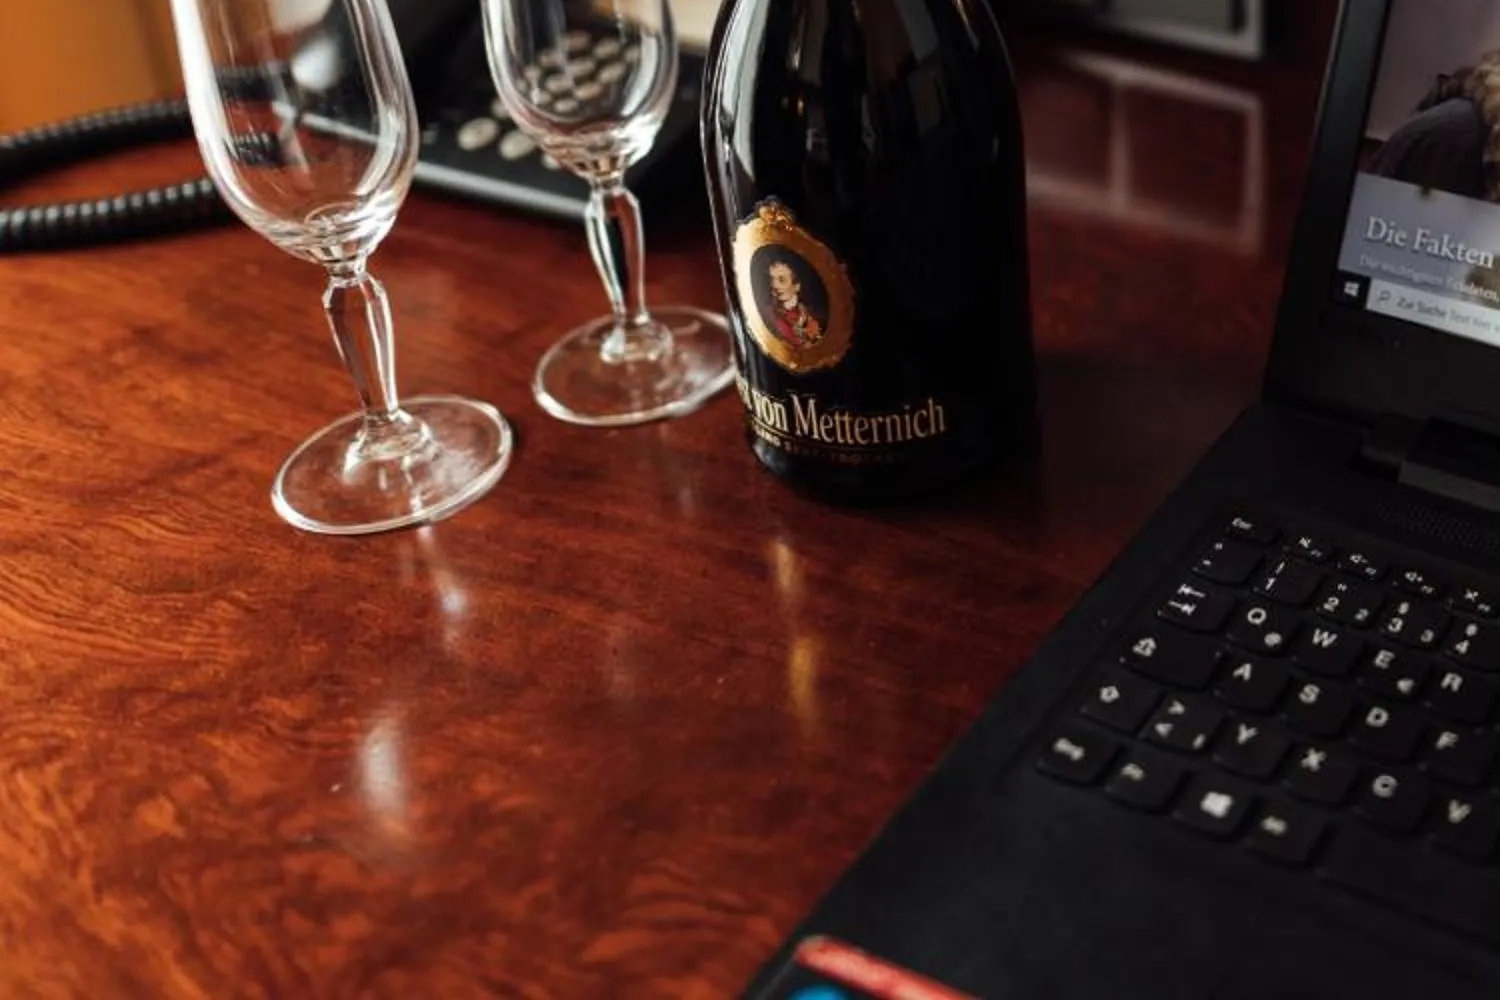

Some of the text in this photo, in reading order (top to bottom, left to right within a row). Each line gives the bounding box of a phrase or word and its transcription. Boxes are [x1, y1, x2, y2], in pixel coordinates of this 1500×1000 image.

[1366, 215, 1407, 247] Die
[1413, 226, 1495, 270] Fakten
[790, 393, 947, 447] Metternich
